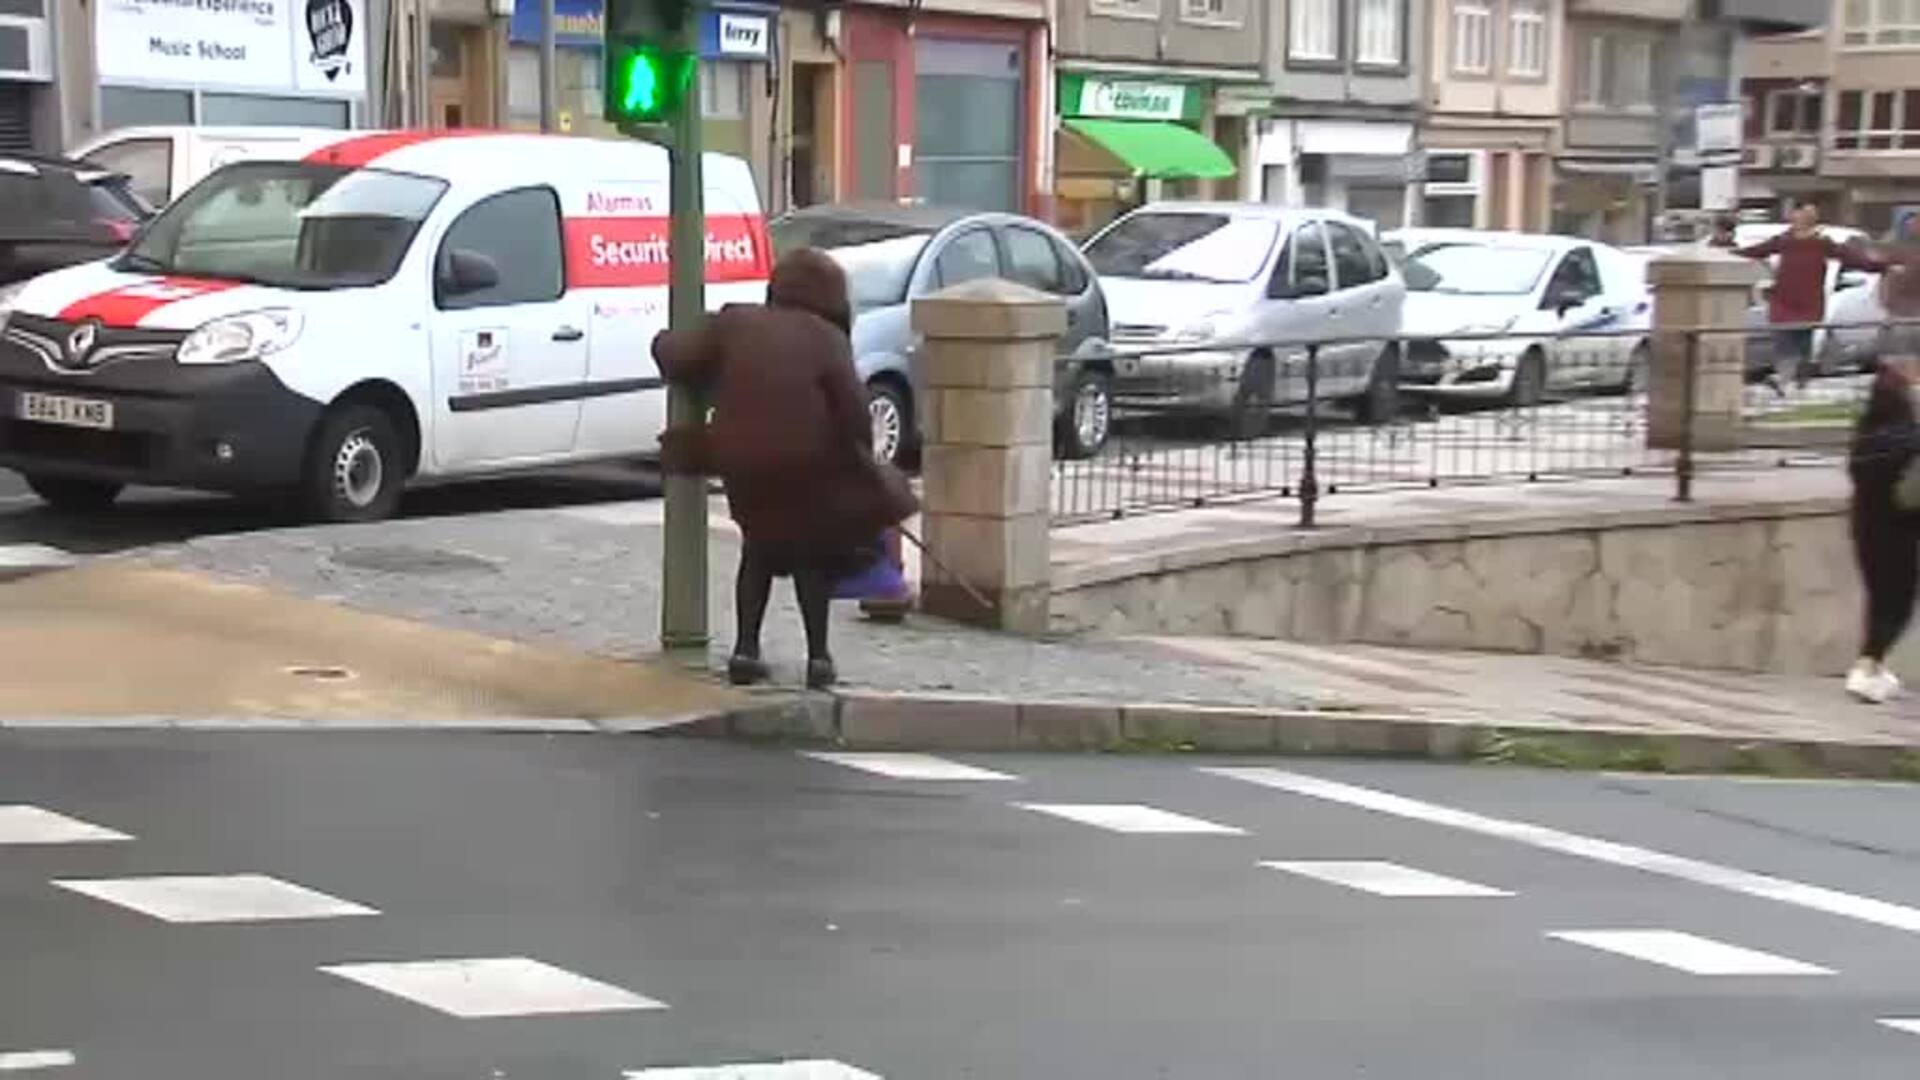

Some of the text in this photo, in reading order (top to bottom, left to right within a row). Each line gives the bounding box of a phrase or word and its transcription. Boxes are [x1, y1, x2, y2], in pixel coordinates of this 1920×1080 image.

[149, 37, 246, 60] Music School
[587, 191, 653, 212] Alarmas
[590, 231, 753, 266] Securit irect
